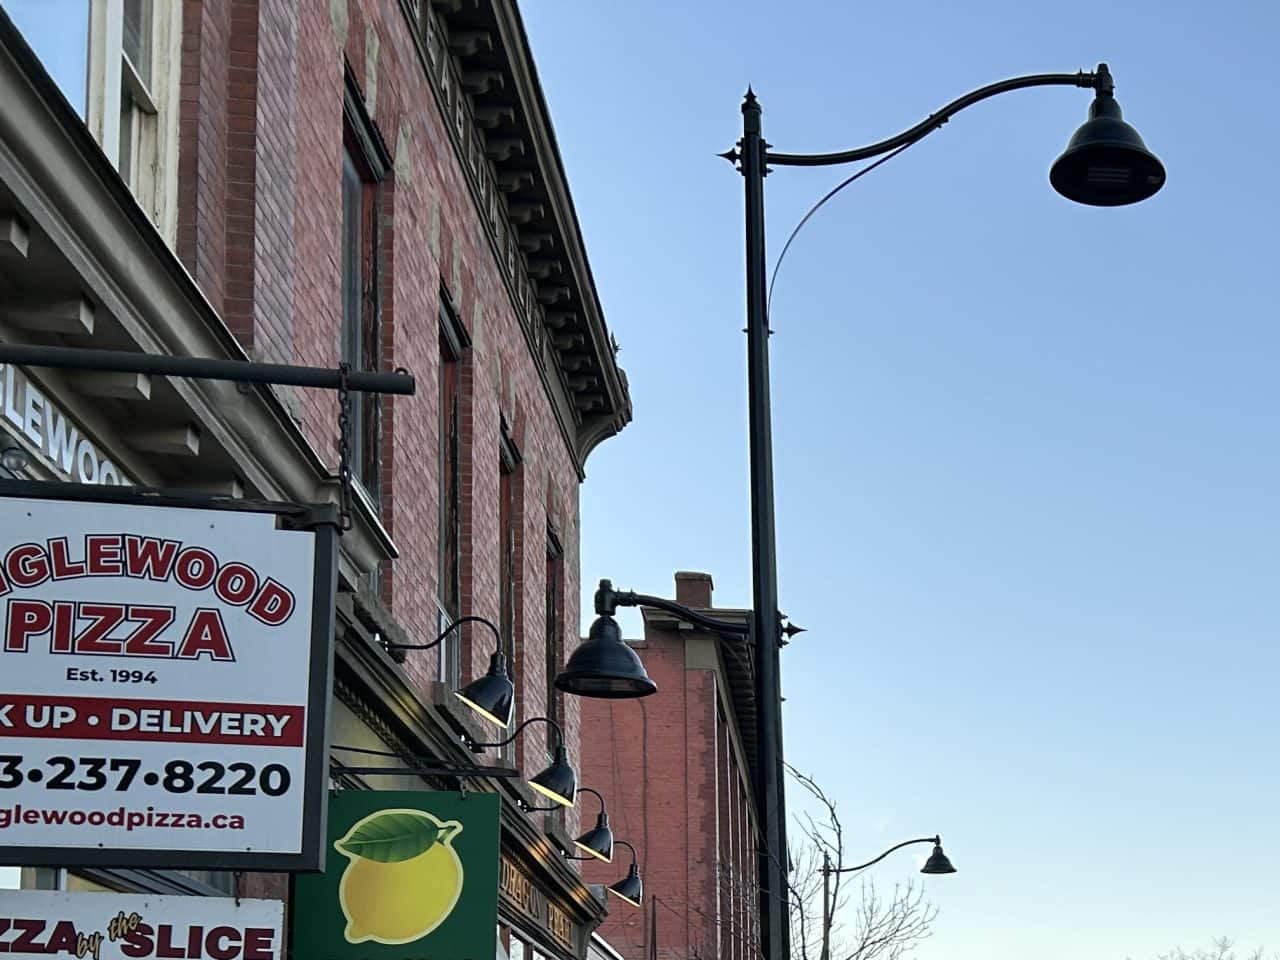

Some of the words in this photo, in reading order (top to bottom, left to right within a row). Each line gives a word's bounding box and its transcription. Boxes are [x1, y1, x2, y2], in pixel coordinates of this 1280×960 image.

[0, 534, 295, 626] GLEWOOD
[5, 599, 236, 662] PIZZA
[66, 668, 104, 681] Est.
[110, 669, 158, 684] 1994
[25, 705, 77, 729] UP
[111, 708, 290, 736] DELIVERY
[77, 932, 104, 960] by
[108, 911, 142, 942] the
